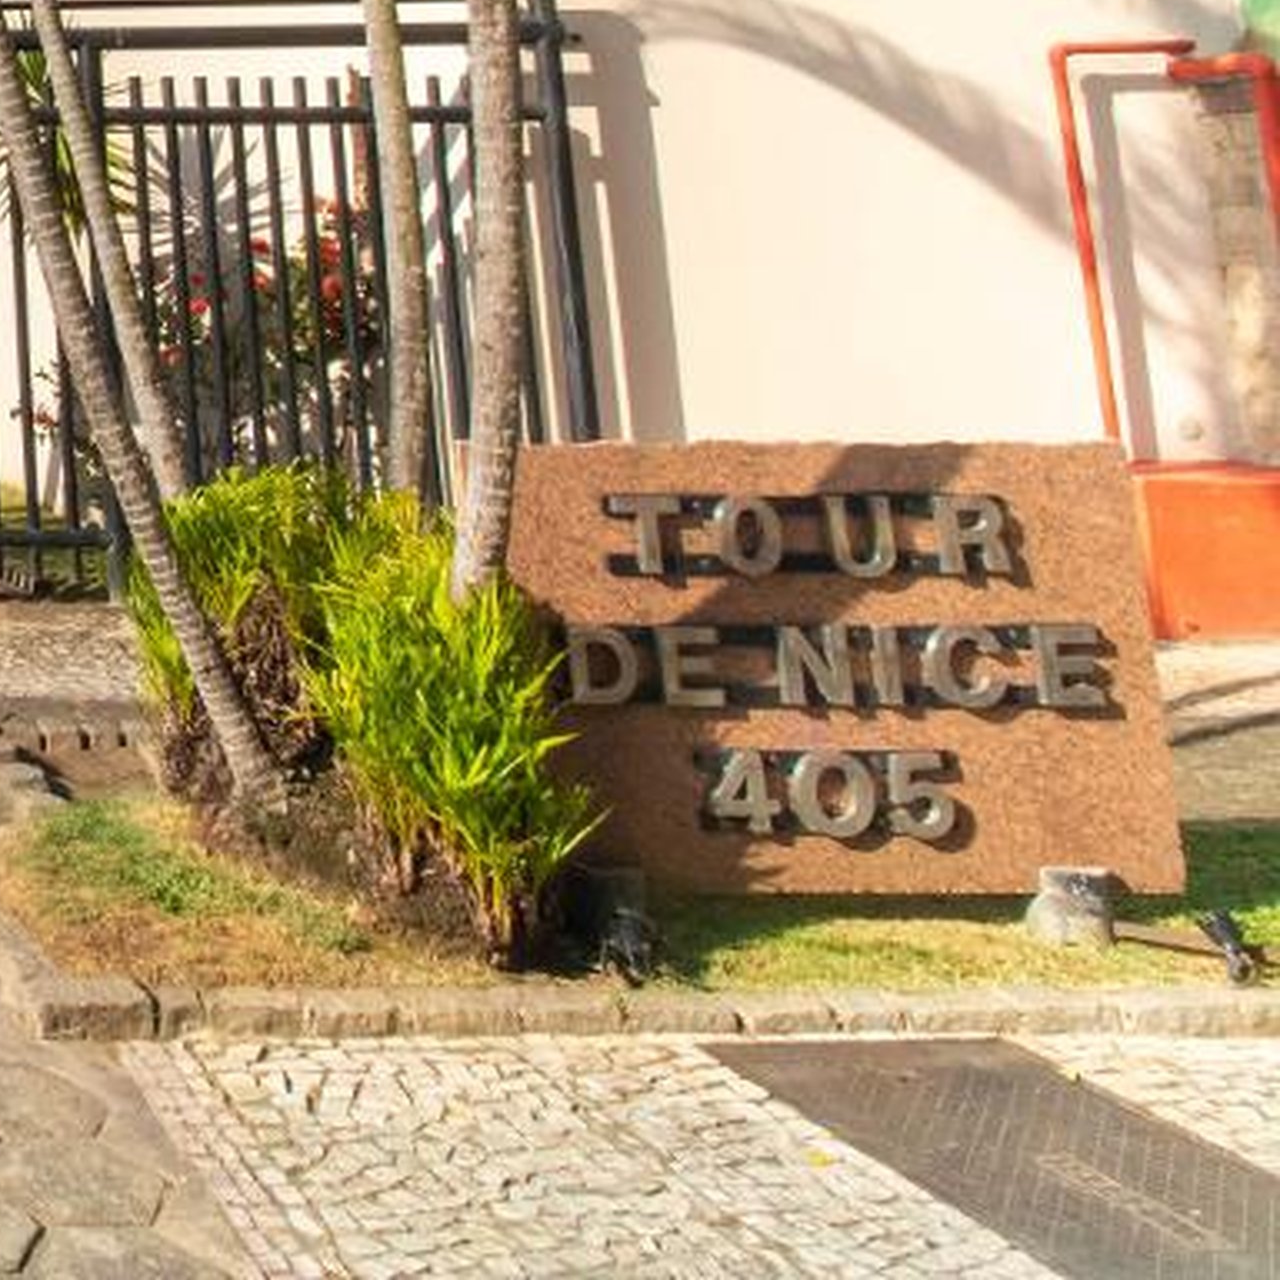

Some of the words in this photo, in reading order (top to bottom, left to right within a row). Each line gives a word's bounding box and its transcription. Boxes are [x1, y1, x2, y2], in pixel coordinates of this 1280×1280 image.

[606, 494, 1014, 578] TOUR
[566, 625, 728, 707] DE
[776, 623, 1109, 710] NICE
[708, 748, 958, 842] 405
